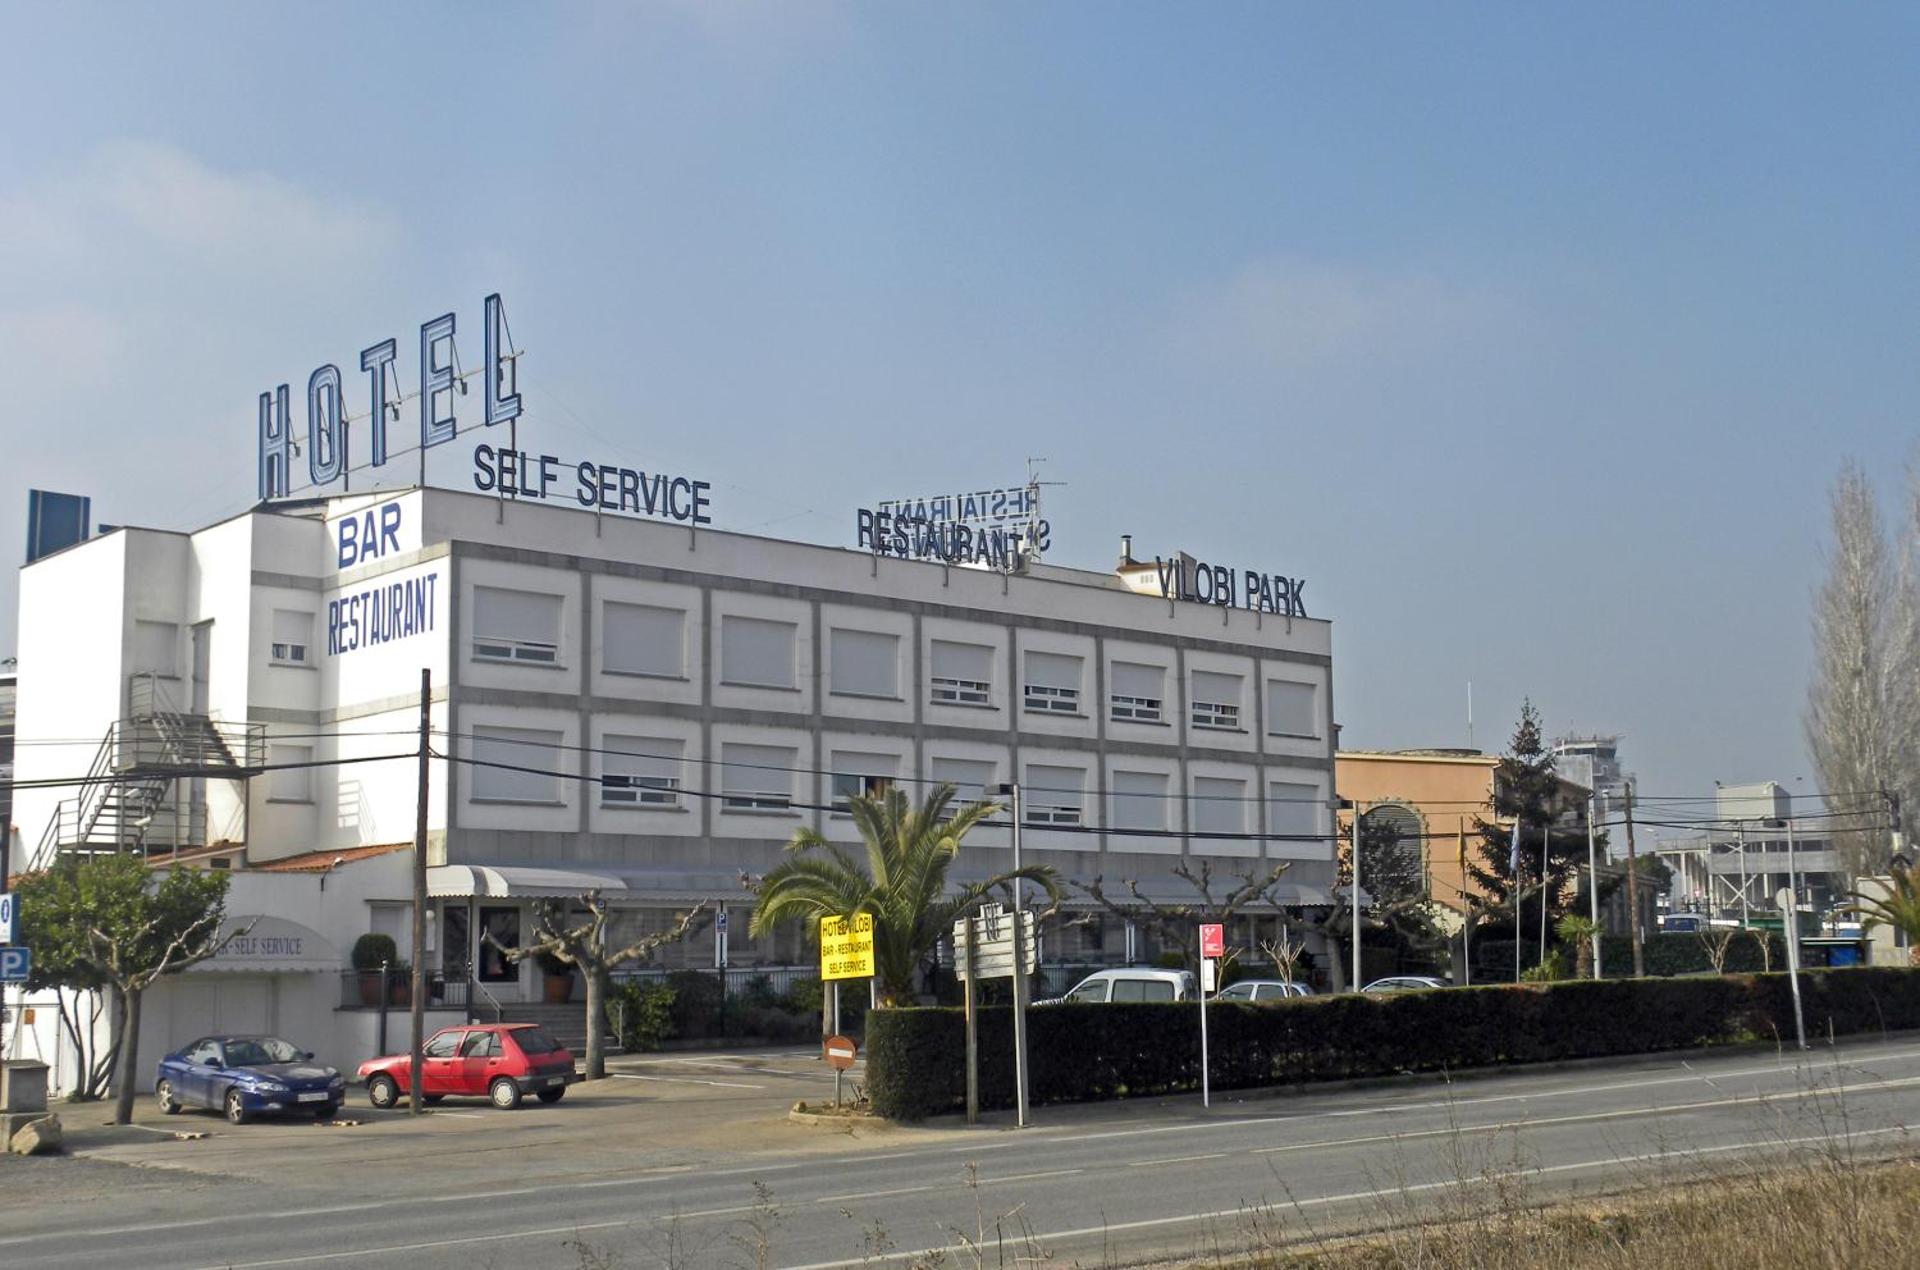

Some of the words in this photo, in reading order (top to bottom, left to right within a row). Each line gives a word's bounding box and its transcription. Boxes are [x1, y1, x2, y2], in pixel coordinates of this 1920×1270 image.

[259, 293, 522, 499] HOTEL
[474, 444, 558, 498] SELF
[577, 461, 711, 524] SERVICE
[338, 502, 402, 569] BAR
[858, 508, 1024, 571] RESTAURANT
[328, 573, 438, 656] RESTAURANT
[1156, 555, 1236, 608] VILOBI
[1245, 570, 1307, 618] PARK
[260, 937, 302, 955] SERVICE
[822, 944, 834, 957] BAR
[829, 962, 843, 974] SELF
[843, 960, 866, 973] SERVICE
